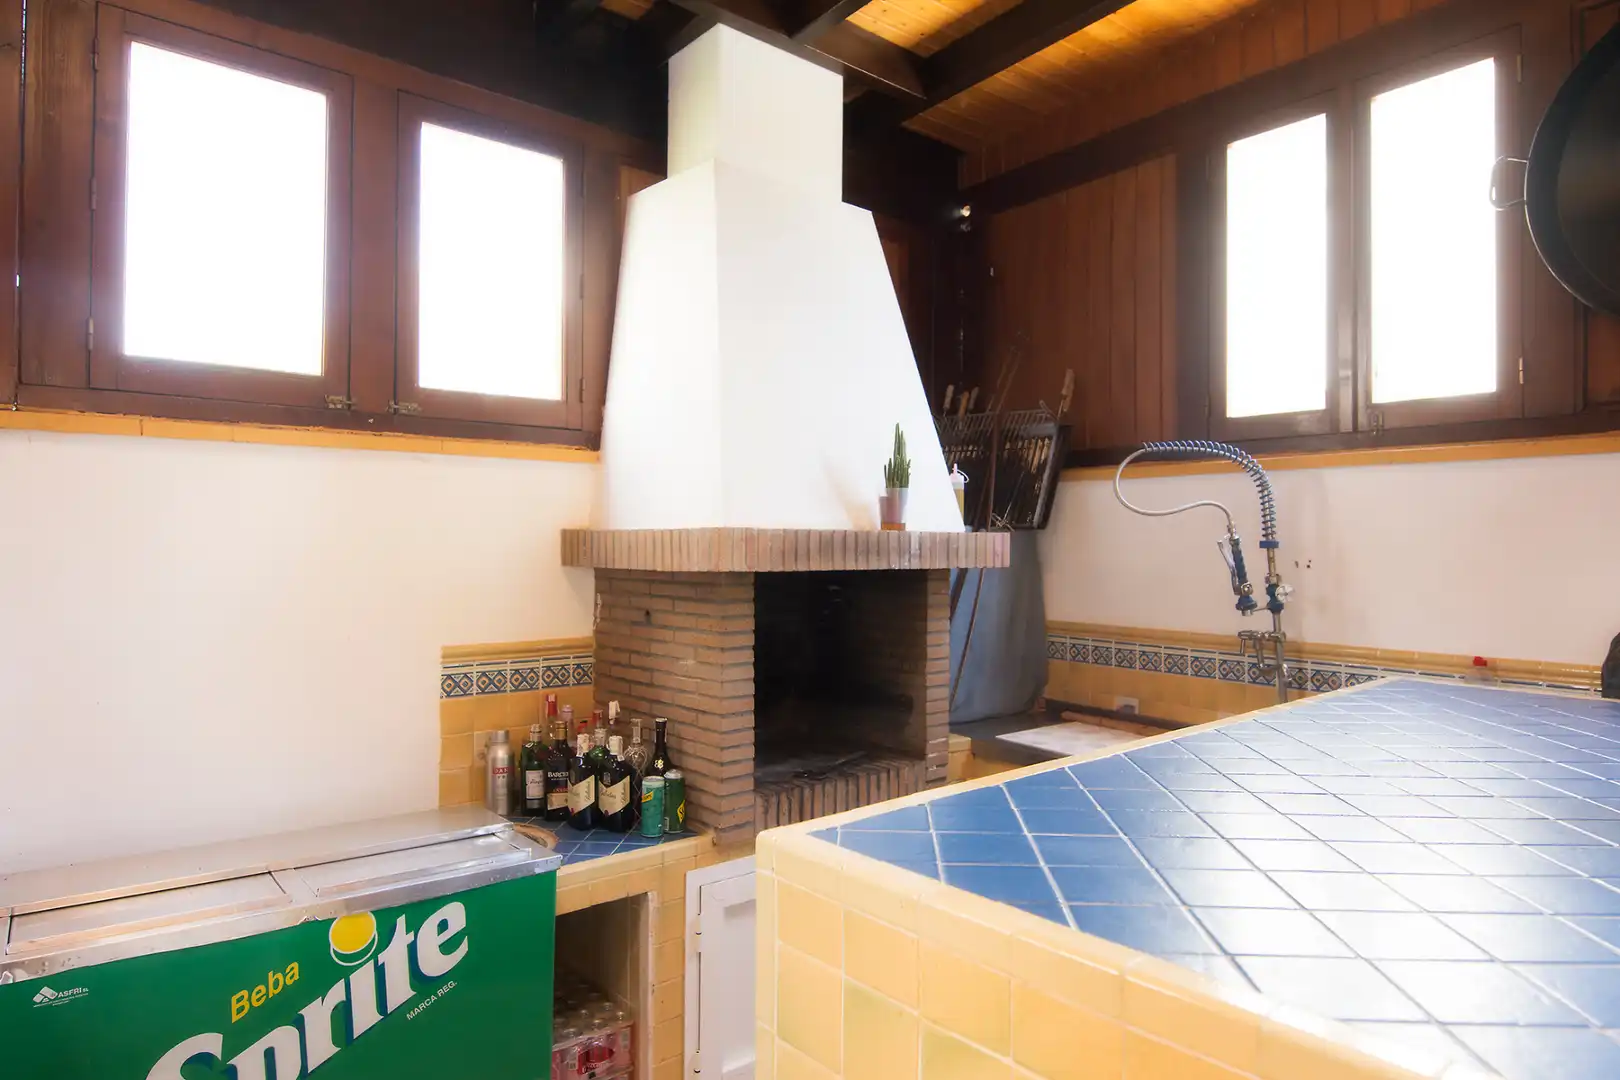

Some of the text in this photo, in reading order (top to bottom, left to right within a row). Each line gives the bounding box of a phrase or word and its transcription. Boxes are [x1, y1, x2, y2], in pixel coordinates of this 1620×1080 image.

[58, 987, 82, 998] ASFRI
[231, 962, 300, 1024] Beba
[406, 980, 458, 1021] MARCA REG.
